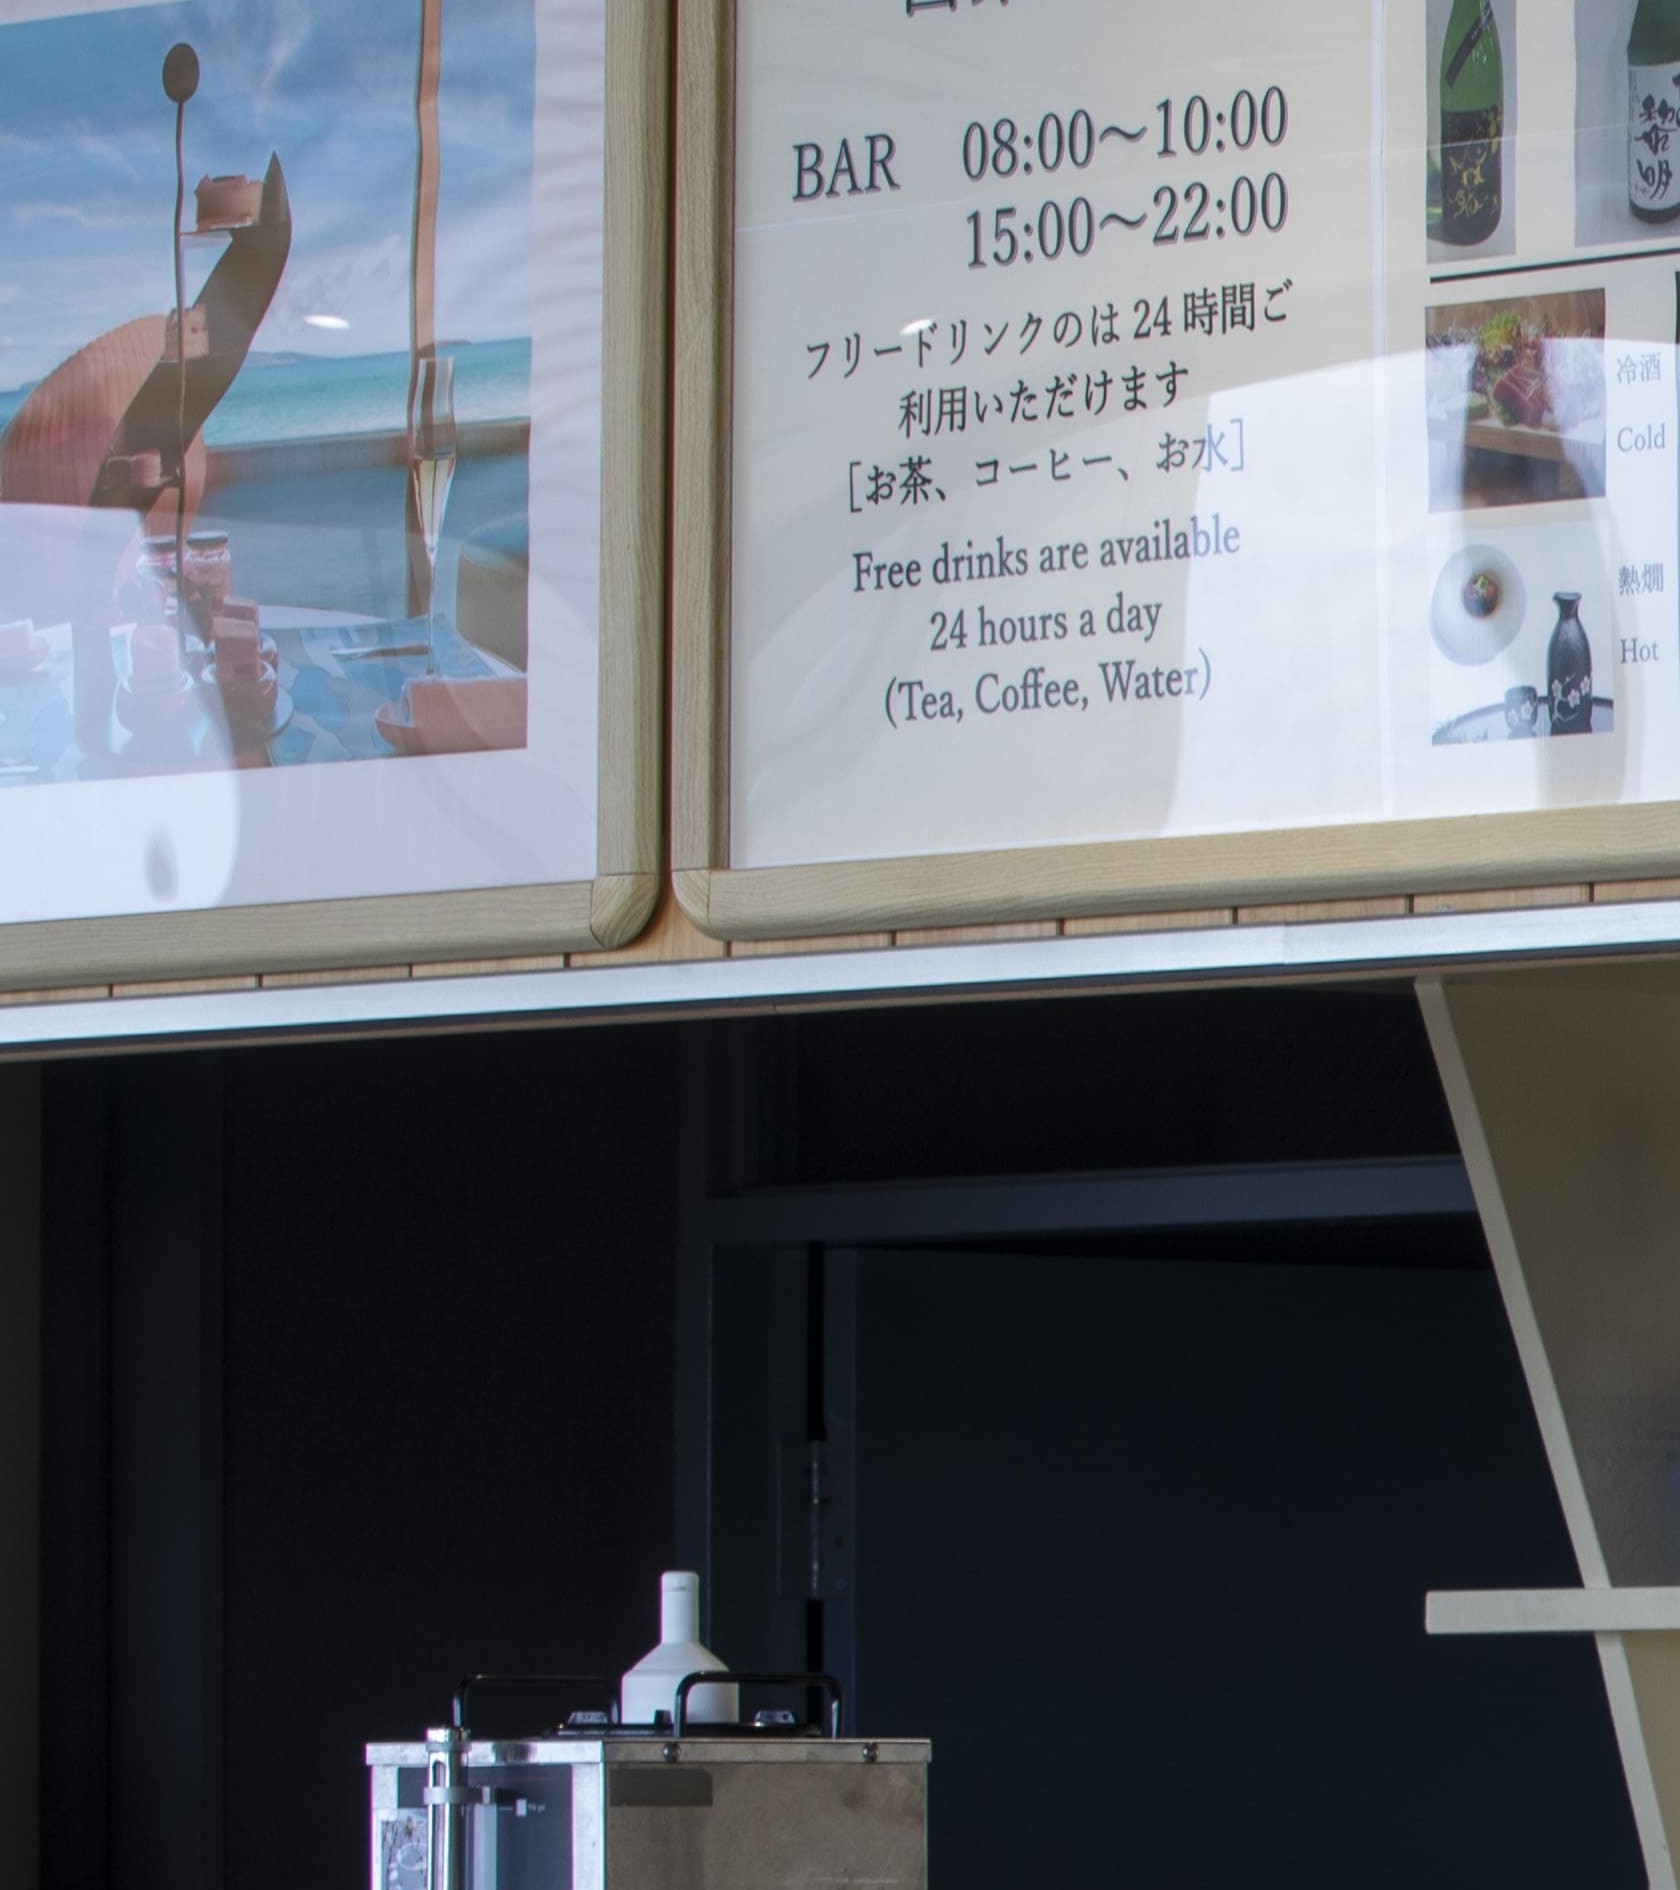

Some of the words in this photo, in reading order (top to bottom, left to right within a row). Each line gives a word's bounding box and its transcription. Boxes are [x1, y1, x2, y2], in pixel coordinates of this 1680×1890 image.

[793, 134, 900, 201] BAR
[1134, 296, 1172, 339] 24
[1184, 278, 1292, 336] 時間ご
[1617, 352, 1661, 384] 冷酒
[899, 361, 1188, 438] 利用いただけます
[1617, 423, 1665, 452] Cold
[853, 552, 921, 592] Free
[932, 536, 1028, 584] drinks
[1039, 534, 1089, 572] are
[1100, 514, 1239, 567] available
[931, 609, 967, 651] 24
[978, 605, 1067, 646] hours
[1080, 610, 1096, 637] a
[1107, 591, 1162, 642] day
[1620, 638, 1658, 664] Hot
[885, 677, 963, 728] (Tea,
[976, 667, 1088, 714] Coffee,
[1098, 648, 1210, 702] Water)
